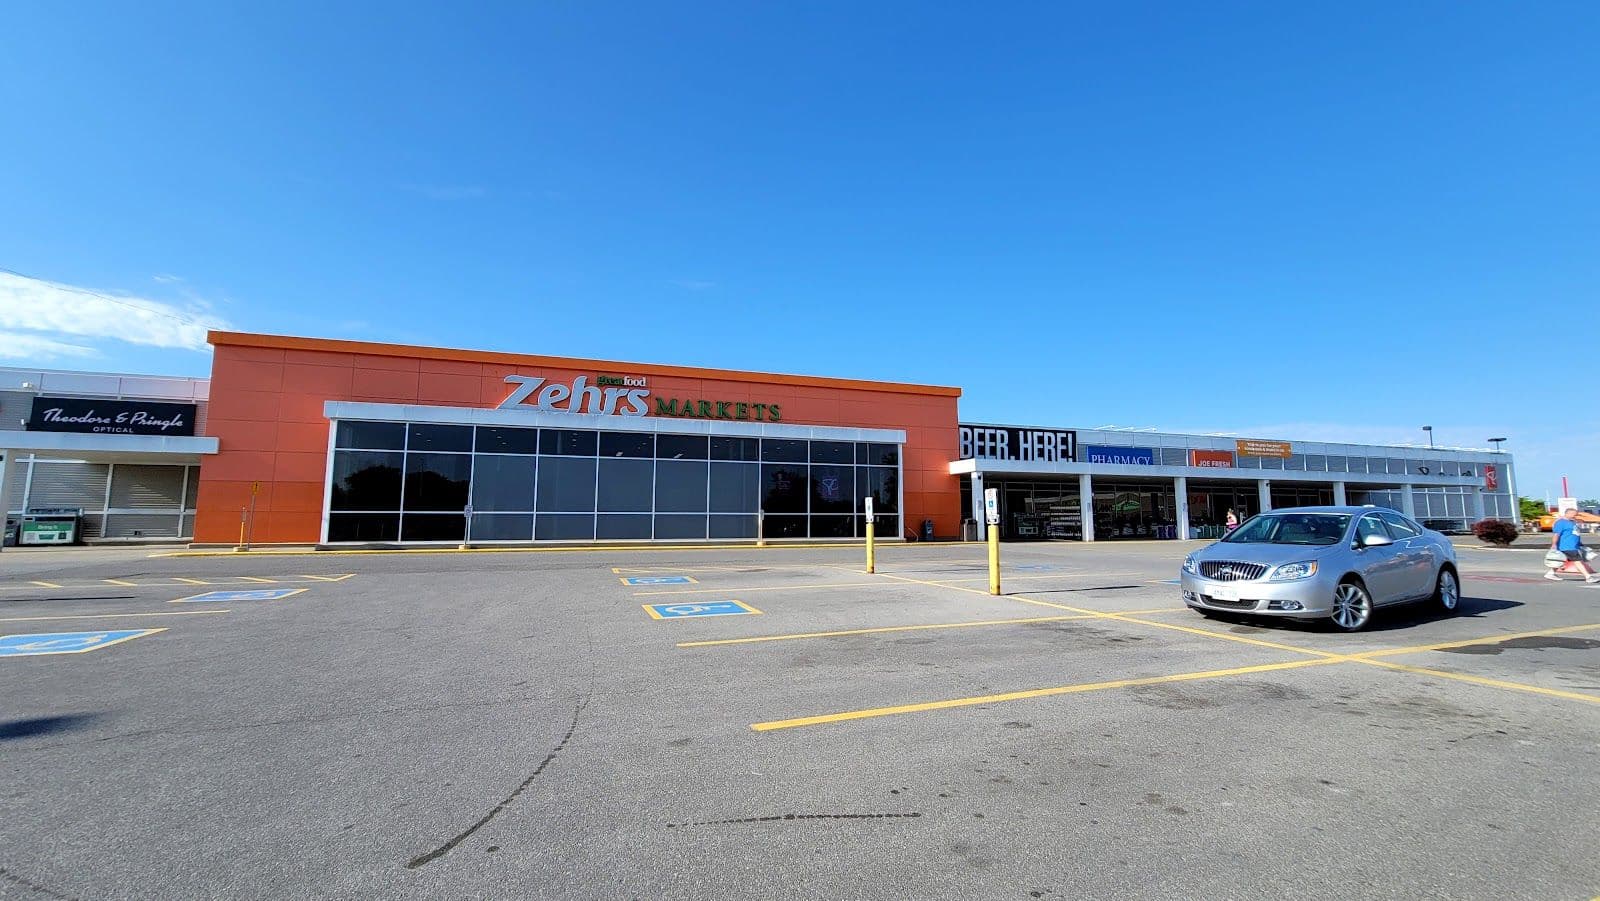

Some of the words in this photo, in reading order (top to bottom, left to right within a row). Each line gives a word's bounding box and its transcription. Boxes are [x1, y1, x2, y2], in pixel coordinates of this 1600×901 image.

[496, 374, 651, 417] Zehrs
[655, 397, 781, 421] MARKETS
[43, 408, 111, 424] Theodore
[115, 411, 129, 423] &
[130, 410, 184, 431] Pringle
[93, 426, 134, 434] OPTICAL
[1018, 430, 1074, 462] HERE!
[1091, 454, 1151, 465] PHARMACY
[1198, 459, 1211, 467] JOE
[1211, 460, 1231, 468] FRESH
